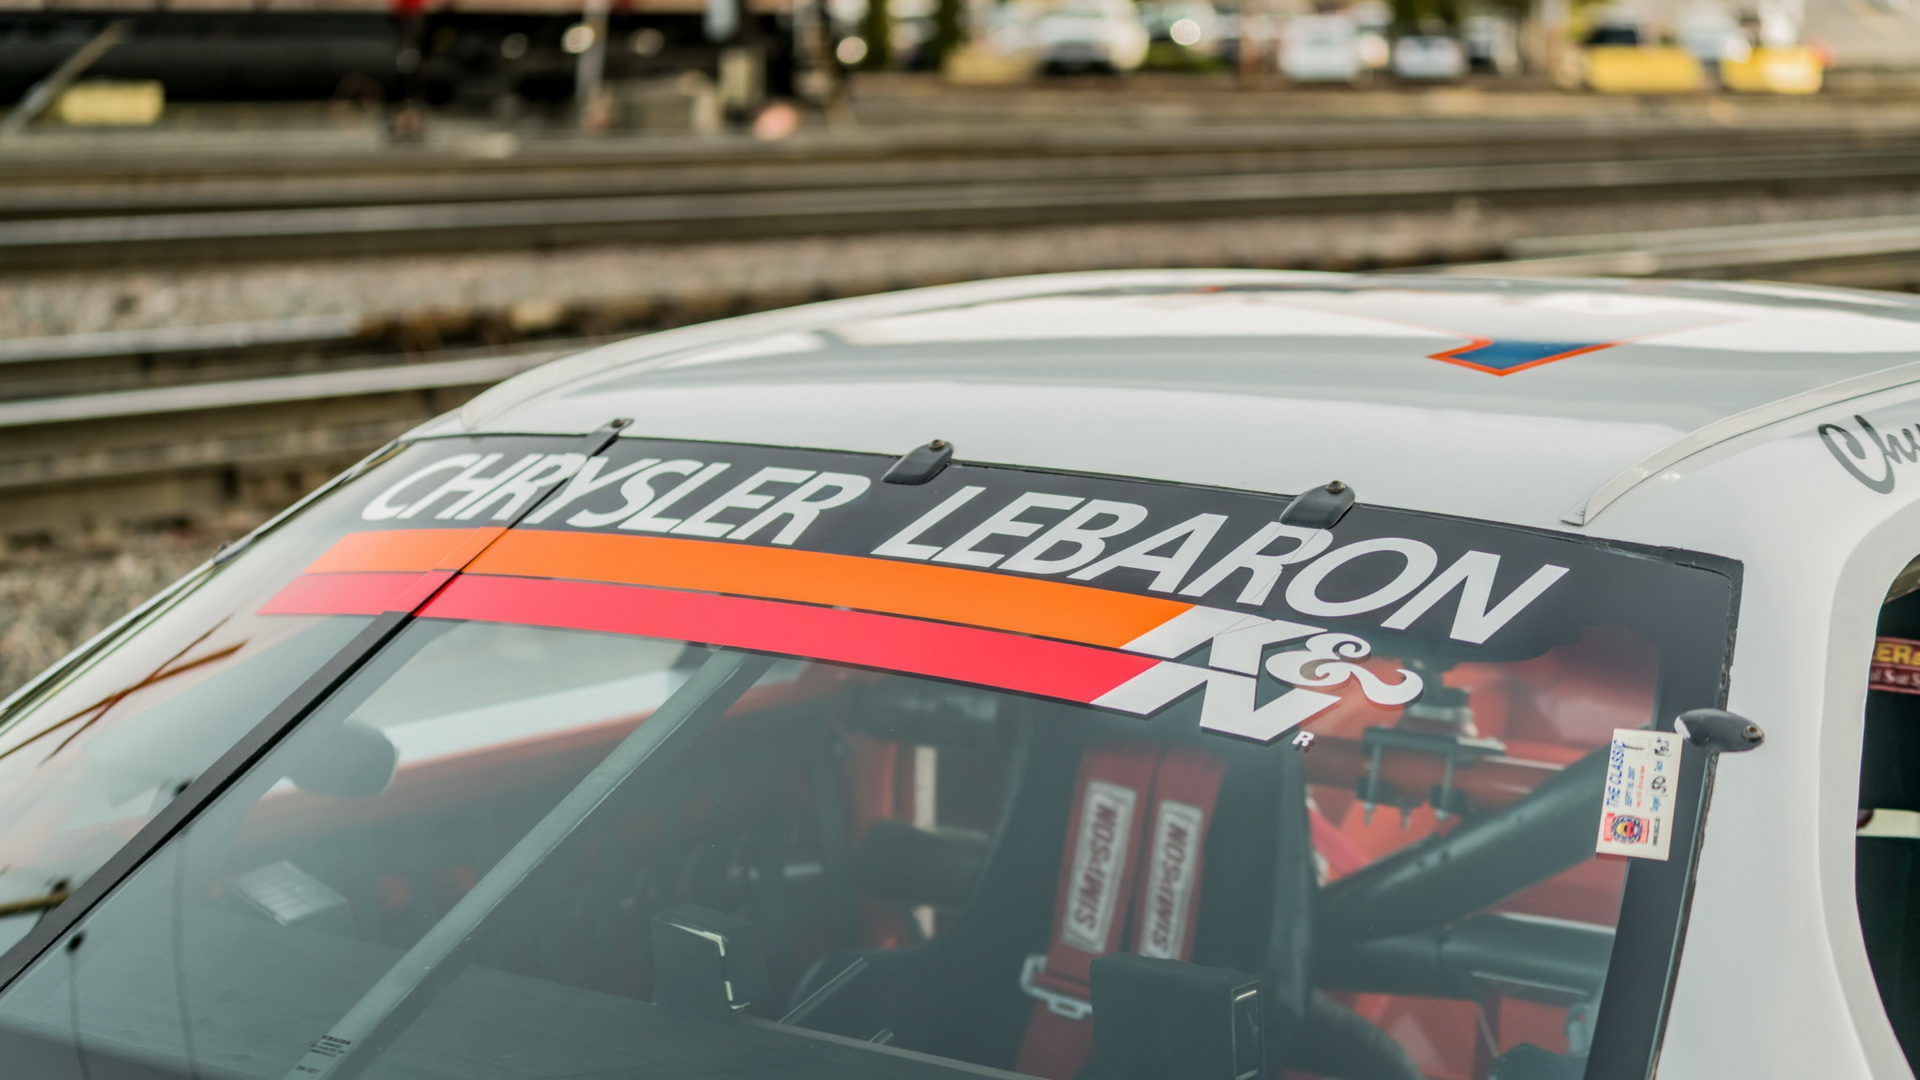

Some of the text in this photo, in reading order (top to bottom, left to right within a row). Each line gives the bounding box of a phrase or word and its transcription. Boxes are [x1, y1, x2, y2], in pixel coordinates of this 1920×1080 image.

[360, 452, 1570, 645] CHRYSLER LEBARON
[1073, 803, 1118, 931] SIMPSON
[1151, 822, 1188, 953] SIMPSON
